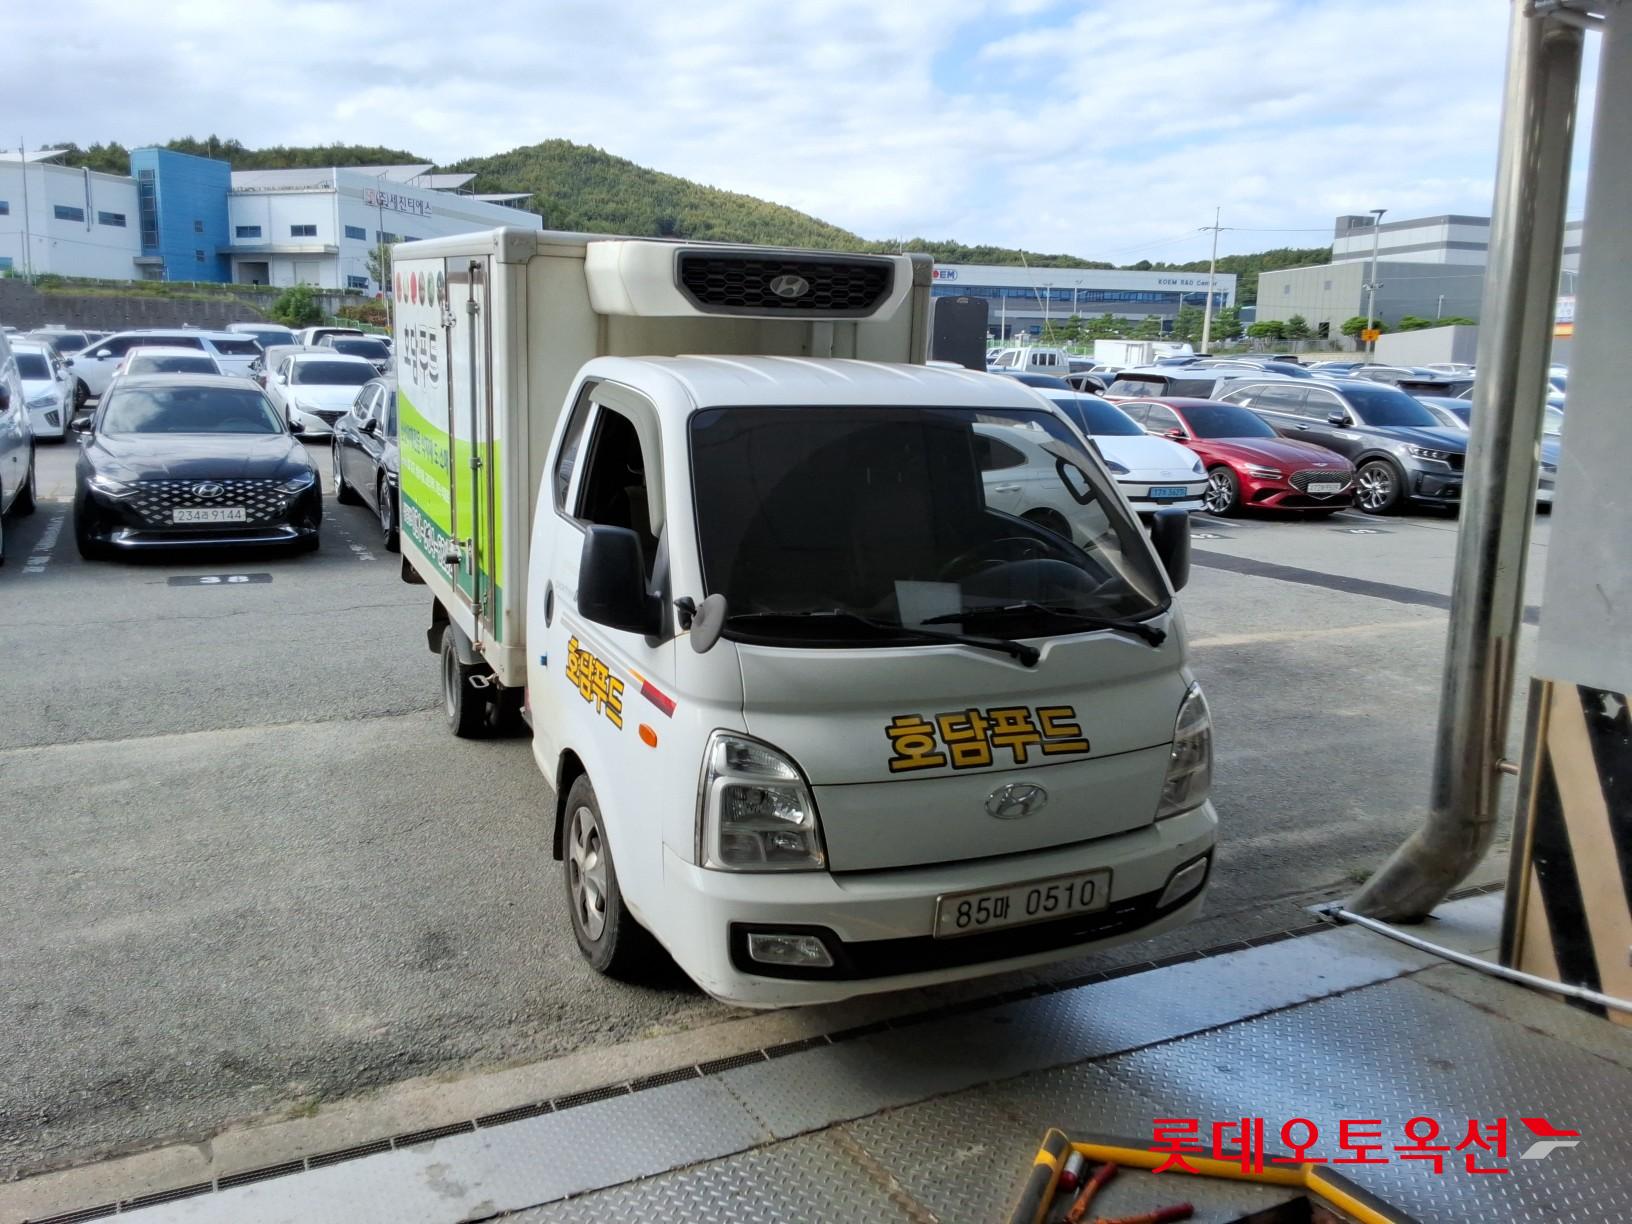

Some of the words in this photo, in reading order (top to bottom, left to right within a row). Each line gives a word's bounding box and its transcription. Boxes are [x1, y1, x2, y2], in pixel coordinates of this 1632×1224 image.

[211, 509, 242, 520] 9144
[566, 633, 625, 730] 호담푸드
[885, 705, 1090, 773] 호담푸드
[956, 894, 1010, 930] 85마
[1025, 879, 1097, 916] 0510
